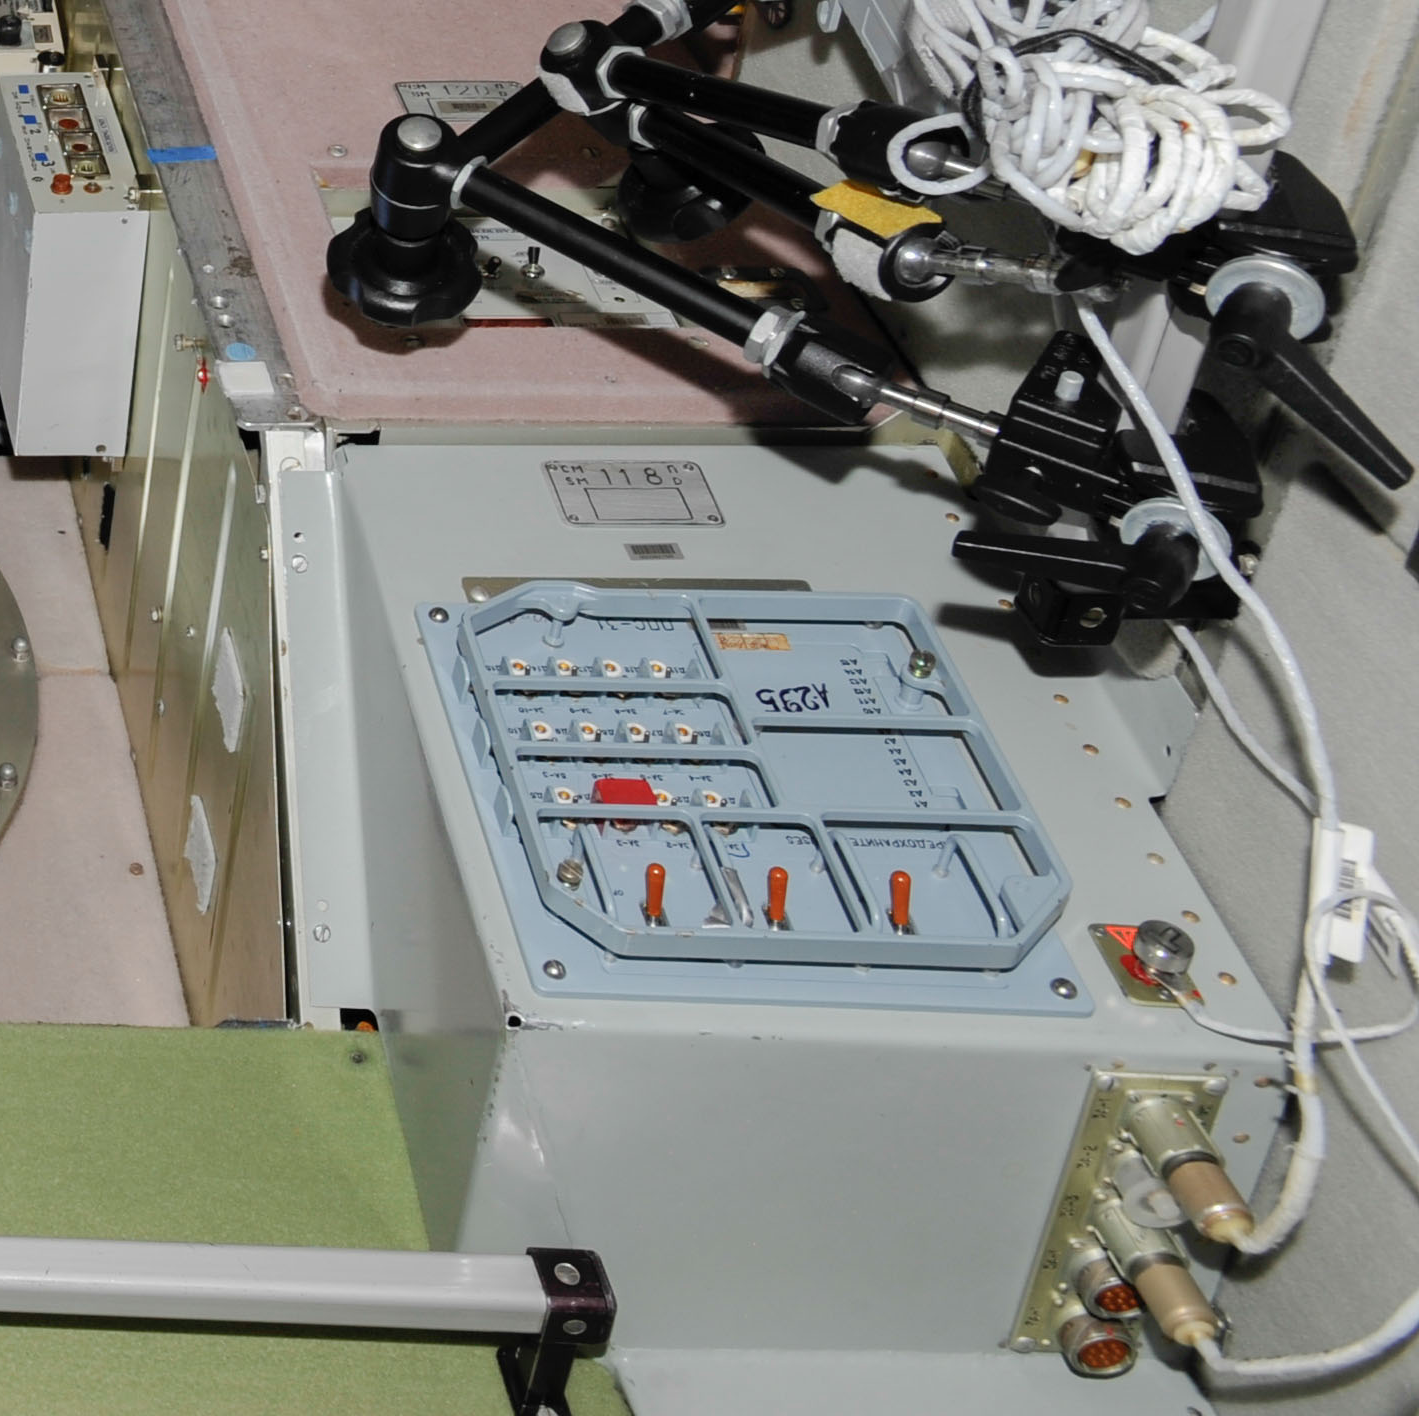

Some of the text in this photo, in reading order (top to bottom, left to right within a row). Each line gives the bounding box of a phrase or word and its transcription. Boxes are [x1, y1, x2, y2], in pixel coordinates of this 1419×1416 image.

[561, 465, 584, 474] СМ
[600, 467, 663, 486] 118
[565, 477, 589, 486] SM
[847, 836, 946, 851] РЕДОХРАНИТЕ
